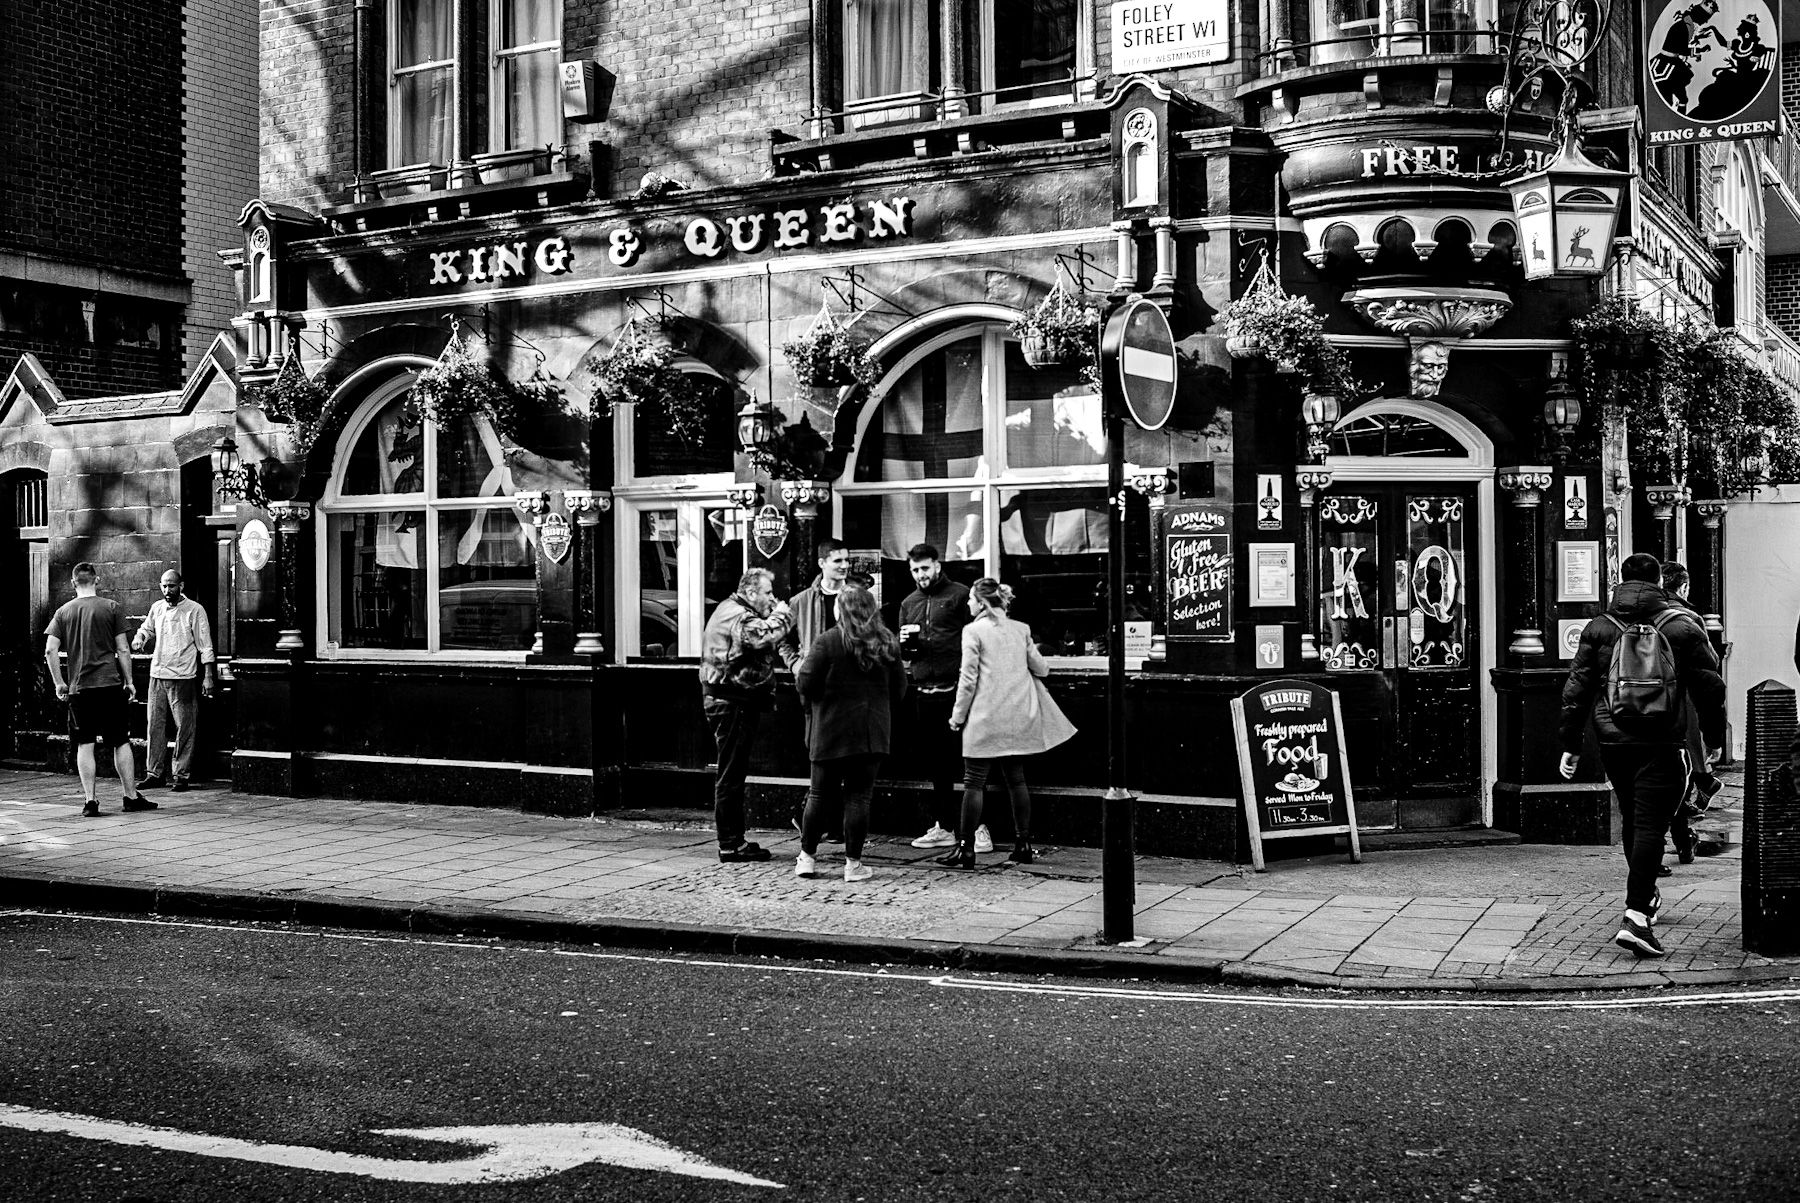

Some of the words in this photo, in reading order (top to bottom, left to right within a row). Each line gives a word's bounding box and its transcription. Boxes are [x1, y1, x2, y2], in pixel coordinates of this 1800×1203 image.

[1123, 3, 1173, 25] FOLEY
[1123, 24, 1185, 48] STREET
[1192, 20, 1216, 38] W1
[1123, 58, 1140, 67] CITY
[1143, 57, 1152, 65] OF
[1155, 48, 1211, 63] WESTMINSTER
[1650, 128, 1695, 142] KING
[1698, 126, 1713, 138] &
[1717, 120, 1776, 137] QUEEN
[1361, 146, 1459, 177] FREE
[430, 236, 569, 285] KING
[608, 228, 640, 266] &
[684, 196, 910, 258] QUEEN
[754, 520, 787, 531] TRIBUTE
[1171, 512, 1225, 529] ADNAMS
[542, 527, 570, 537] TRIBUTE
[1170, 539, 1212, 569] Gluten
[1171, 570, 1225, 602] BEER
[1329, 547, 1369, 619] K
[1411, 545, 1458, 623] Q
[1196, 612, 1220, 630] here!
[1263, 691, 1310, 706] TRIBUTE
[1254, 722, 1287, 740] Freshly
[1288, 718, 1328, 739] prepared
[1262, 735, 1319, 766] Food
[1288, 793, 1304, 802] Mon
[1304, 793, 1311, 801] to
[1311, 791, 1333, 804] Friday
